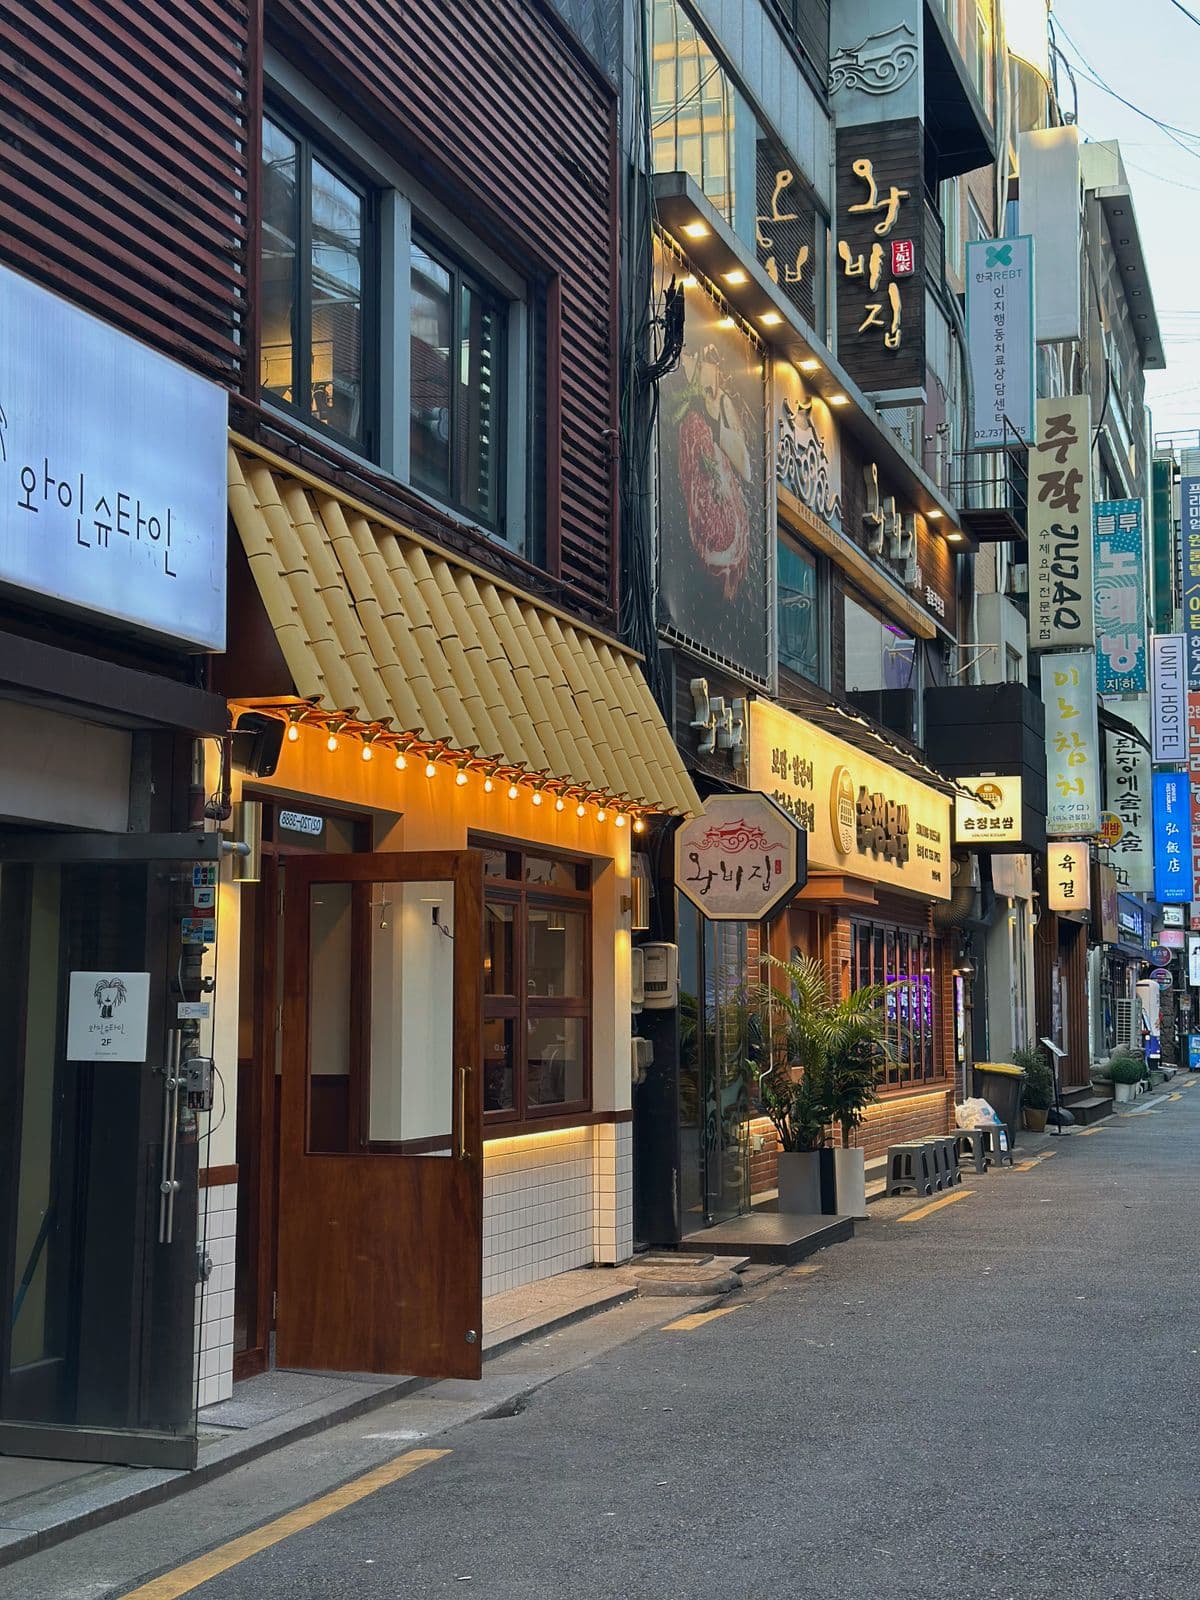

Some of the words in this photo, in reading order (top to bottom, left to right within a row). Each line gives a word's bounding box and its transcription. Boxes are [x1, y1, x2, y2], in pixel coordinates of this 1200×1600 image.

[839, 159, 911, 348] 왕비집
[975, 269, 1023, 283] 한국REBT
[1037, 414, 1083, 513] 주작
[18, 458, 177, 578] 와인슈타인
[1106, 678, 1136, 690] 지하
[1160, 645, 1177, 679] UNIT
[1053, 667, 1087, 797] 미노참치
[1161, 695, 1179, 752] HOSTEL
[857, 785, 910, 864] 손정보쌈
[964, 817, 1014, 830] 손정보쌈
[1165, 823, 1180, 873] 弘飯店
[687, 852, 771, 894] 왕비집
[1058, 854, 1076, 898] 육결
[101, 1038, 112, 1047] 2F
